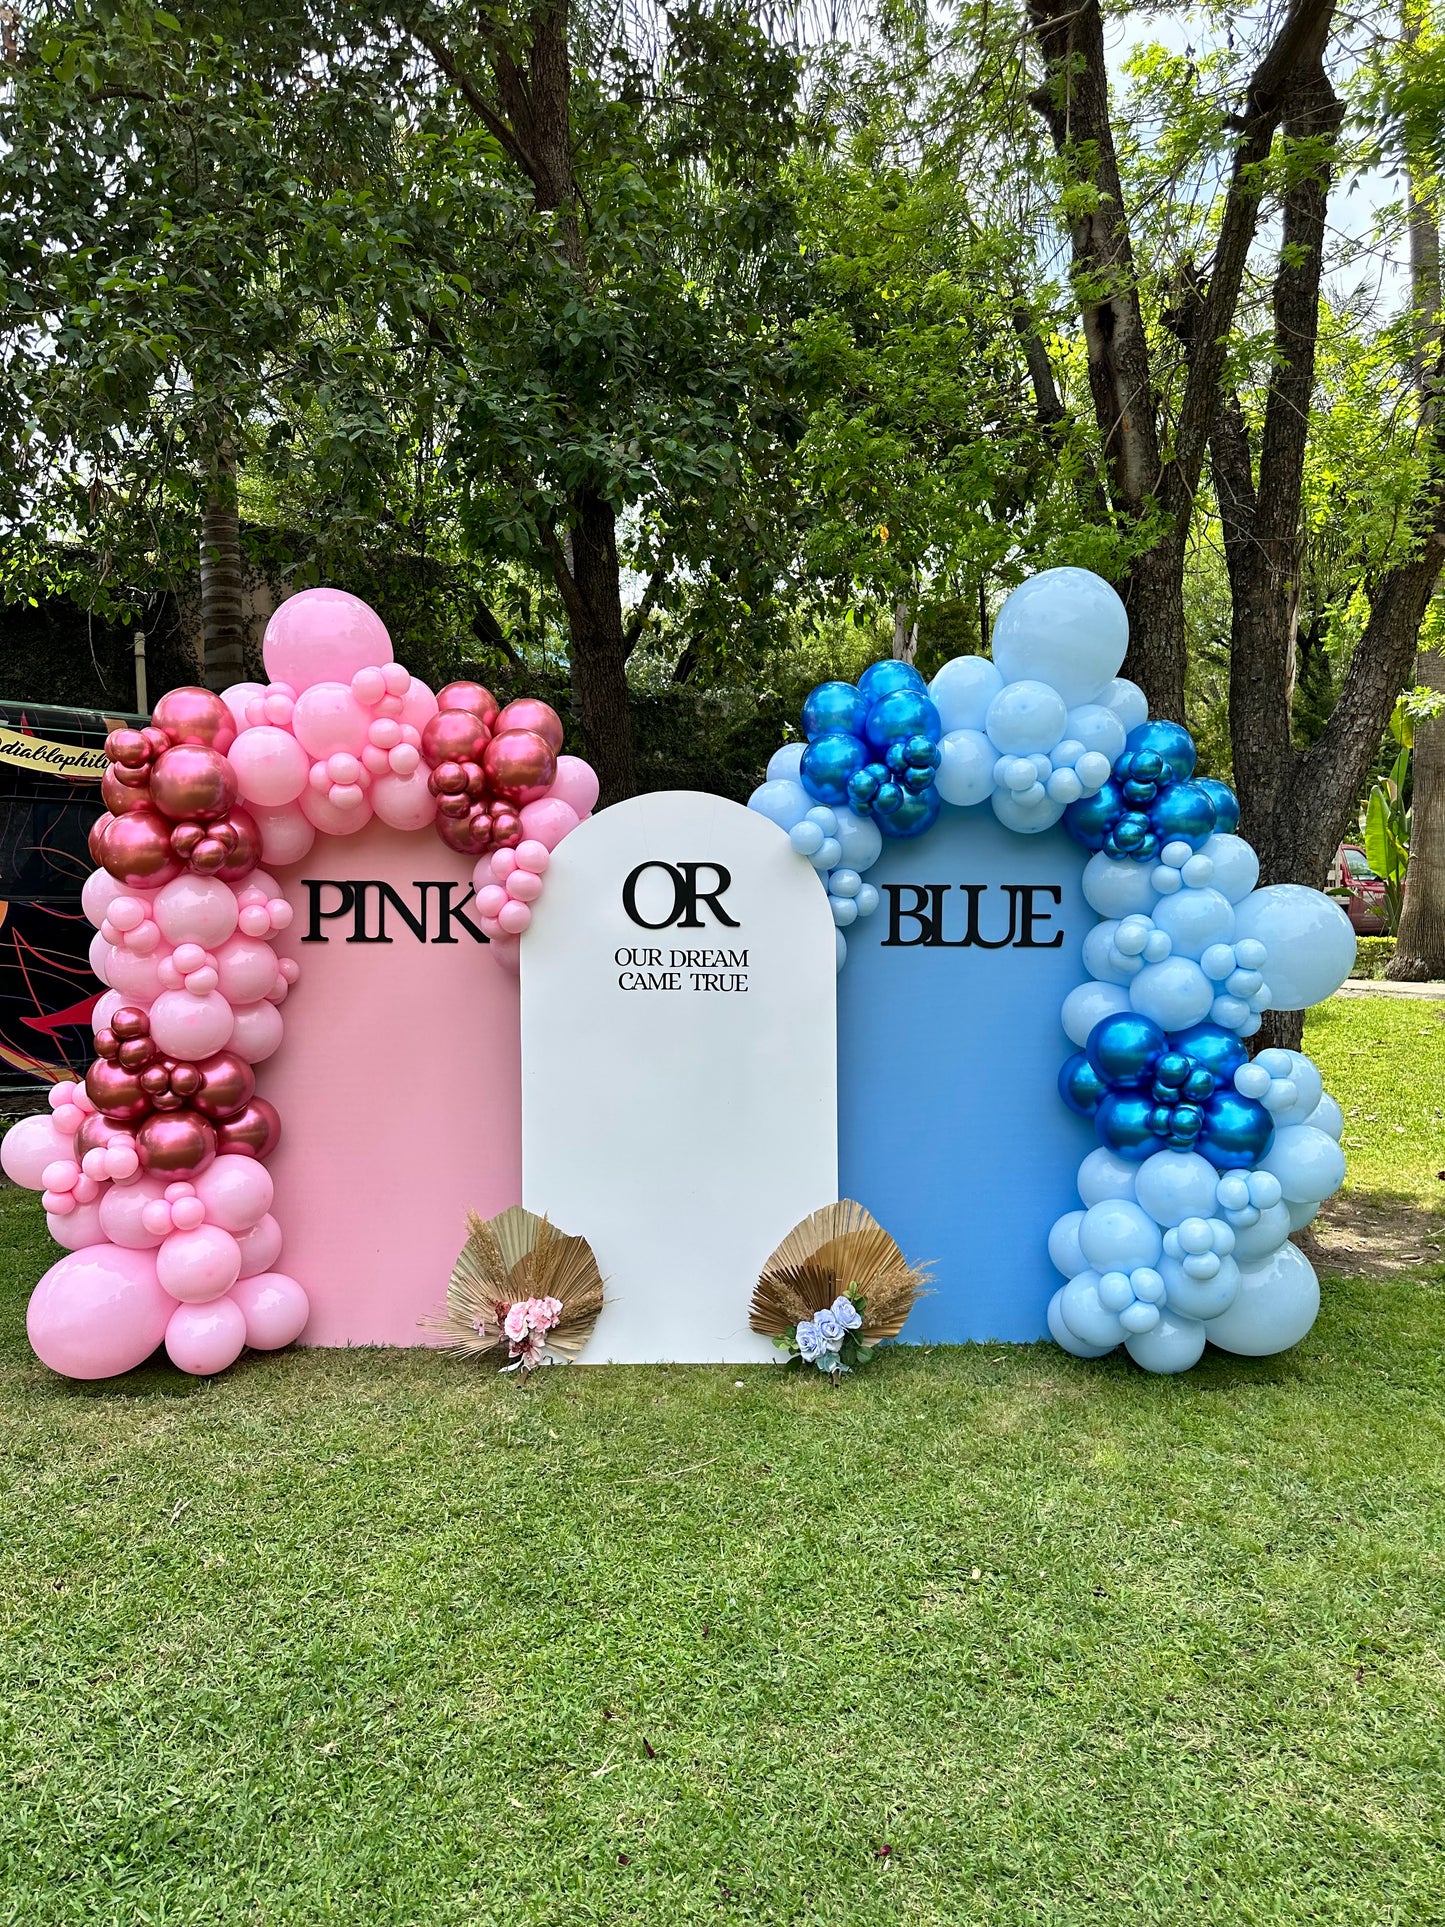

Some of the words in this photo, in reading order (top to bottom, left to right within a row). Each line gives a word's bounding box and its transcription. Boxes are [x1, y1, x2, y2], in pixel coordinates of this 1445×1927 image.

[0, 738, 111, 772] diablophili
[300, 879, 491, 944] PINK
[622, 860, 741, 930] OR
[880, 884, 1065, 949] BLUE
[614, 947, 664, 967] OUR
[669, 949, 750, 968] DREAM
[618, 971, 682, 991] CAME
[689, 973, 749, 992] TRUE
